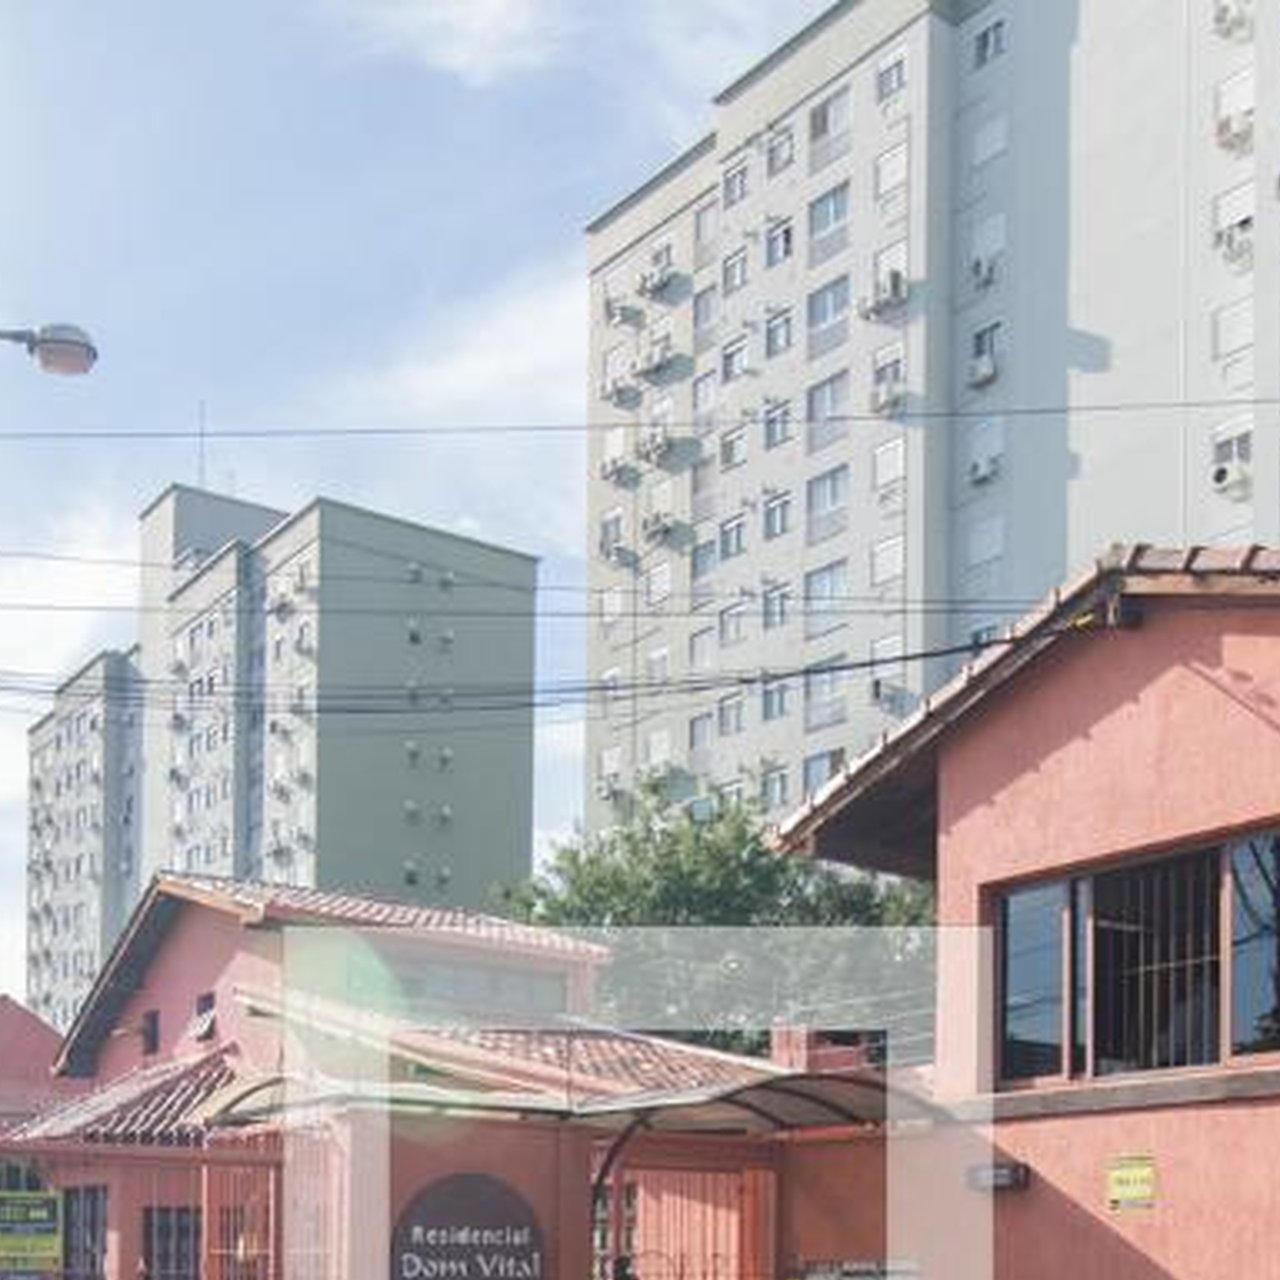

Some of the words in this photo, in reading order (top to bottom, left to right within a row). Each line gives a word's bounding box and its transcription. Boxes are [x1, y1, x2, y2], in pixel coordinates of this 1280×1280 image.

[412, 1226, 529, 1245] Residencial
[401, 1253, 469, 1278] Dom
[476, 1252, 540, 1278] Vital
